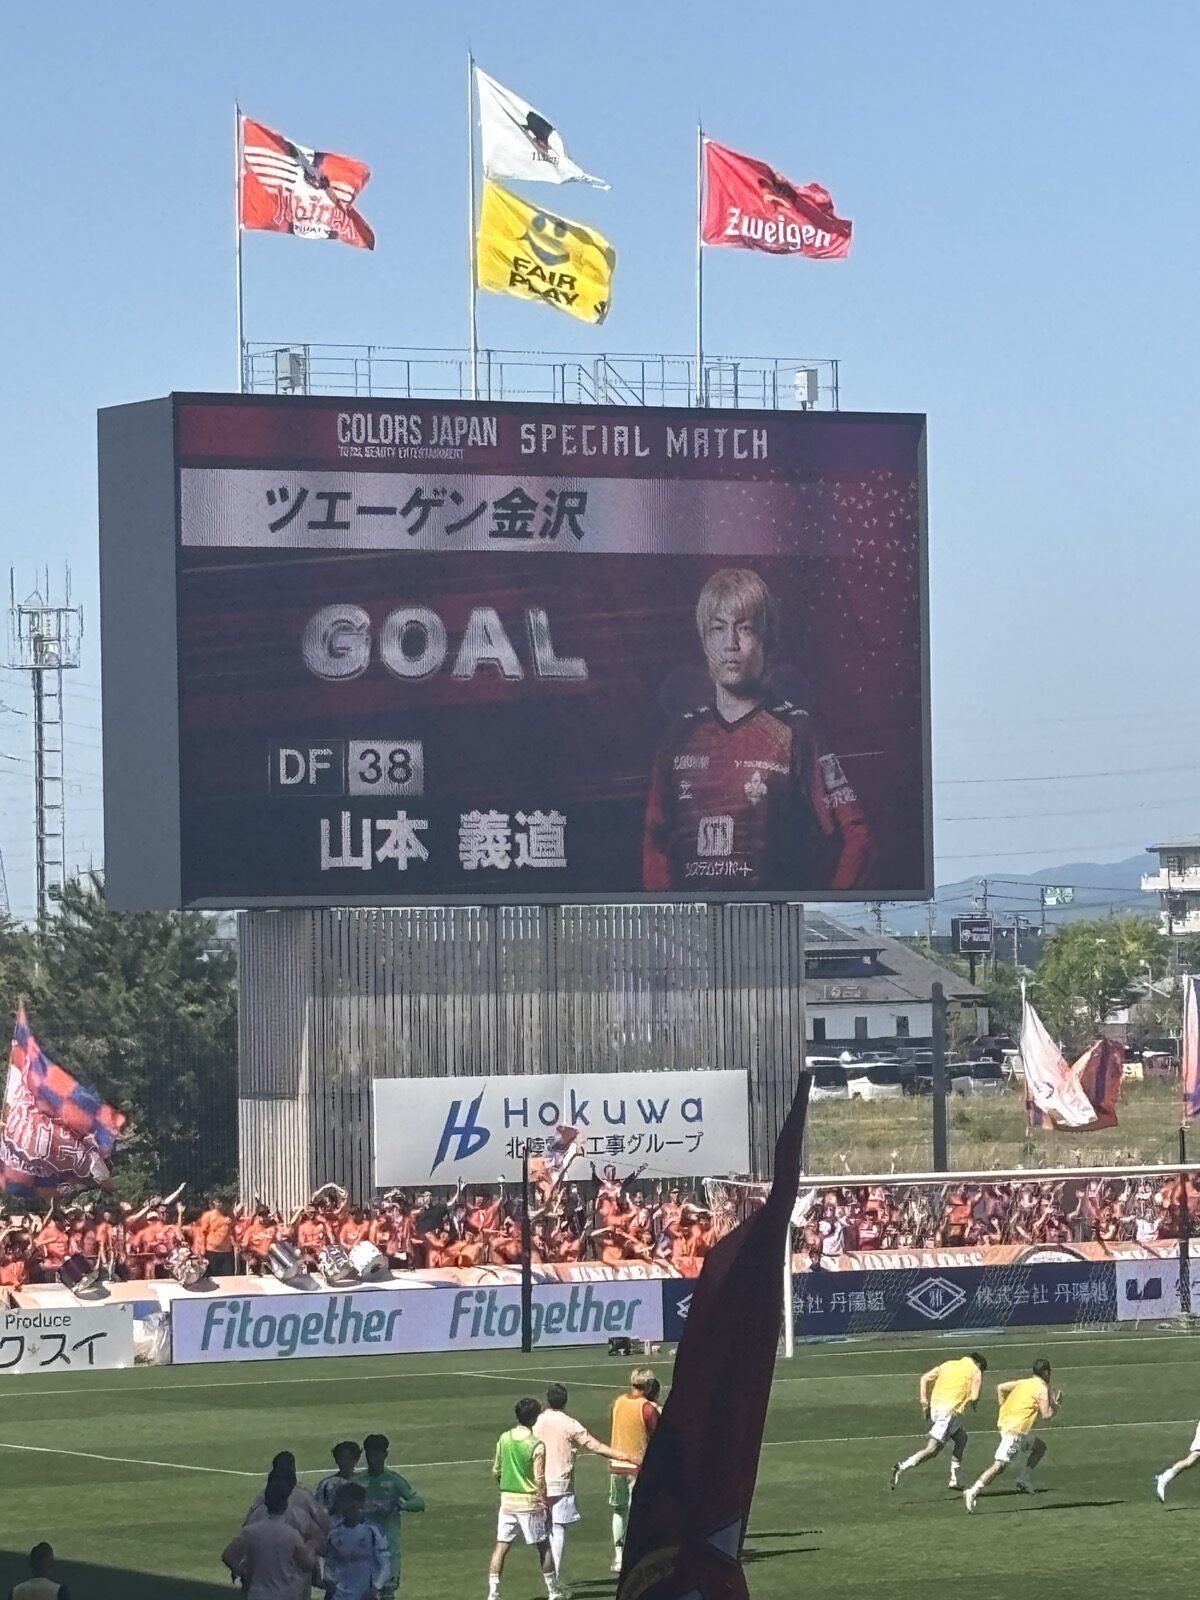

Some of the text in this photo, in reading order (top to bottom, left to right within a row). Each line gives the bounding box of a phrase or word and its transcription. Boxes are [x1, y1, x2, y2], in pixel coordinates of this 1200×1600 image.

[724, 207, 831, 251] Zweigen
[508, 270, 579, 306] PLAY
[513, 256, 577, 290] FAIR
[337, 412, 768, 460] COLORS JAPAN SPECIAL MATCH
[264, 486, 590, 541] ツエーゲン金沢
[302, 604, 590, 681] GOAL
[279, 748, 414, 785] DF 38
[320, 809, 568, 871] 山本 義道
[504, 1089, 703, 1128] Hokuwa
[5, 1313, 72, 1330] Produce
[200, 1296, 403, 1356] Fitogether
